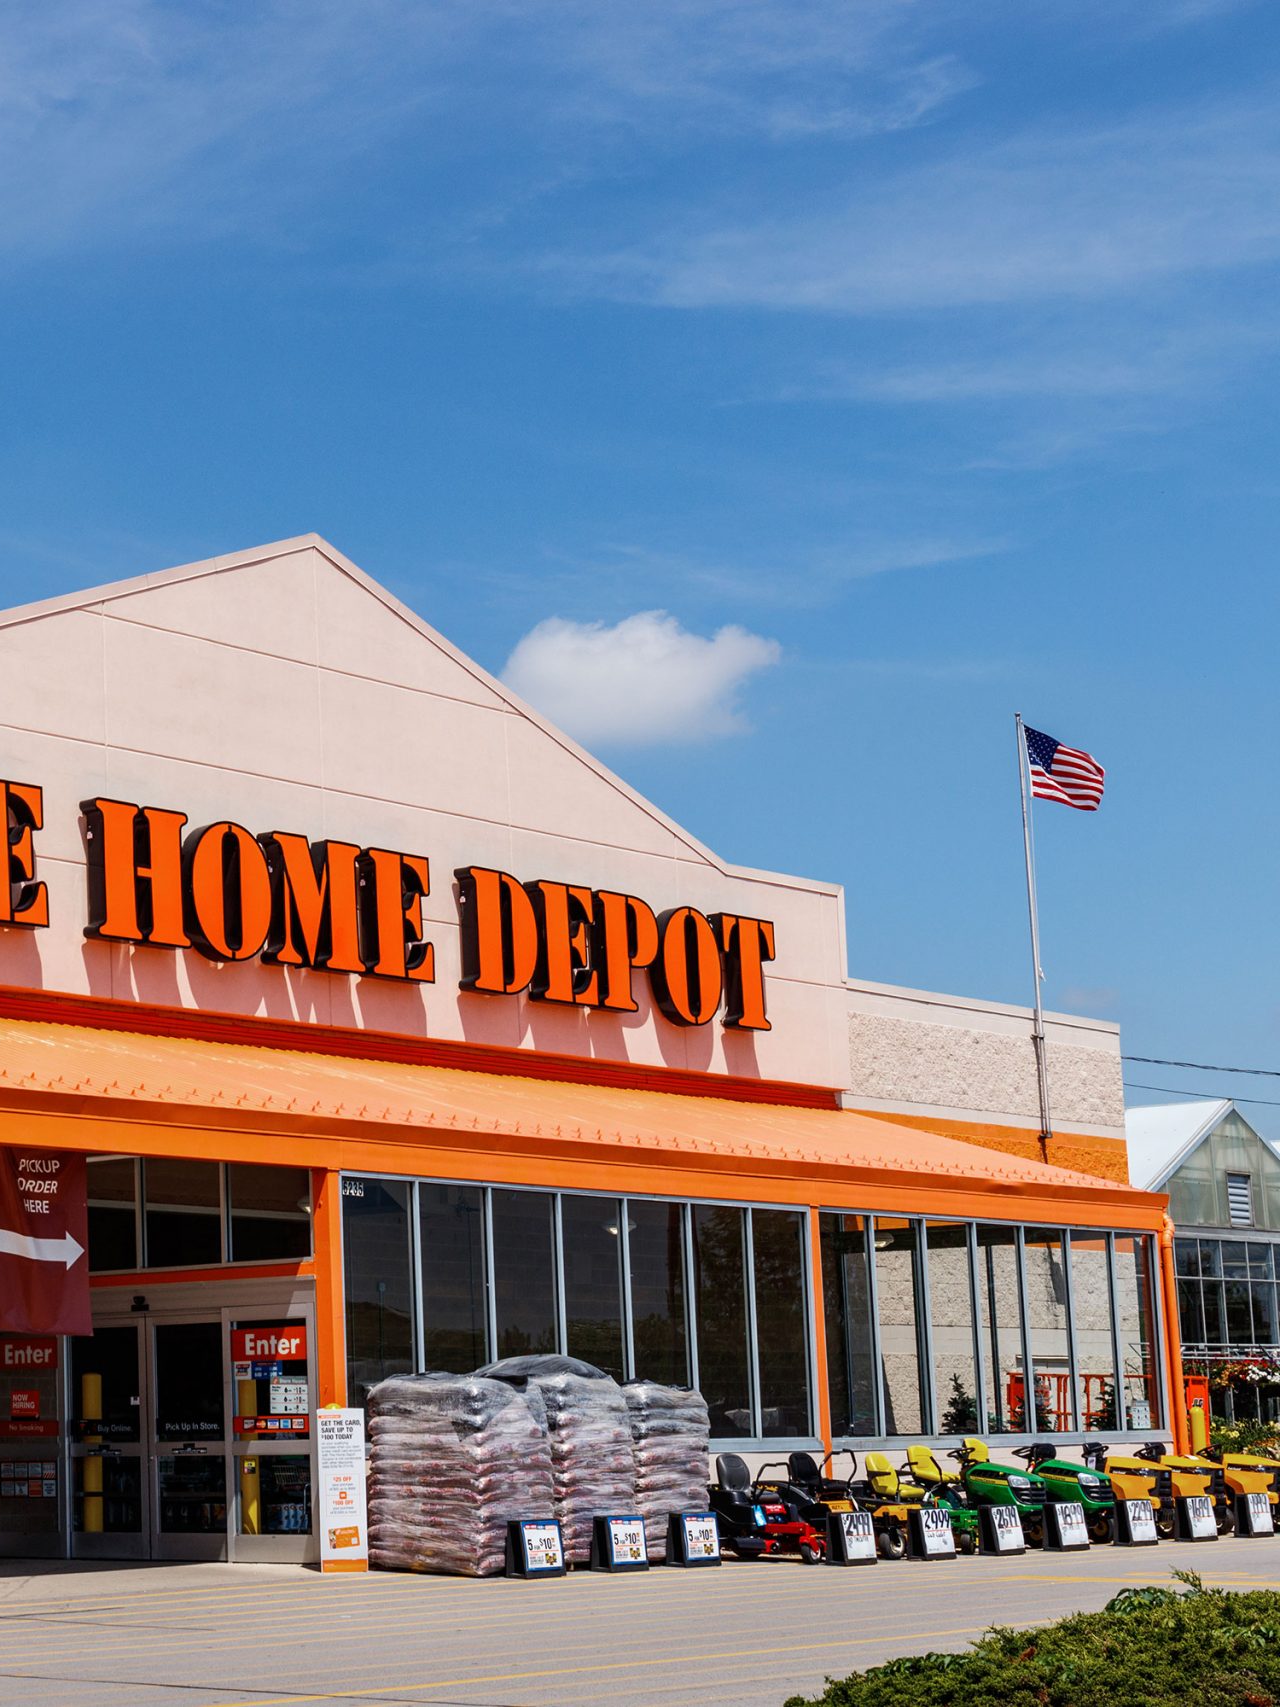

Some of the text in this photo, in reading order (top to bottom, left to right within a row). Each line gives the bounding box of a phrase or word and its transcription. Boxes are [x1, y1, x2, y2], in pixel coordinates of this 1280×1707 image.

[79, 796, 436, 984] HOME
[454, 866, 776, 1031] DEPOT
[18, 1158, 60, 1174] PICKUP
[17, 1177, 58, 1194] ORDER
[23, 1199, 50, 1213] HERE
[245, 1333, 300, 1356] Enter
[4, 1344, 53, 1365] Enter
[12, 1401, 35, 1409] HIRING
[19, 1424, 44, 1434] Smoking
[97, 1424, 133, 1433] Buy Online.
[165, 1422, 220, 1431] Pick Up In Store.
[992, 1506, 1018, 1528] $2699
[842, 1513, 871, 1536] $2499
[613, 1533, 619, 1545] 5
[688, 1530, 694, 1542] 5
[527, 1539, 534, 1551] 5
